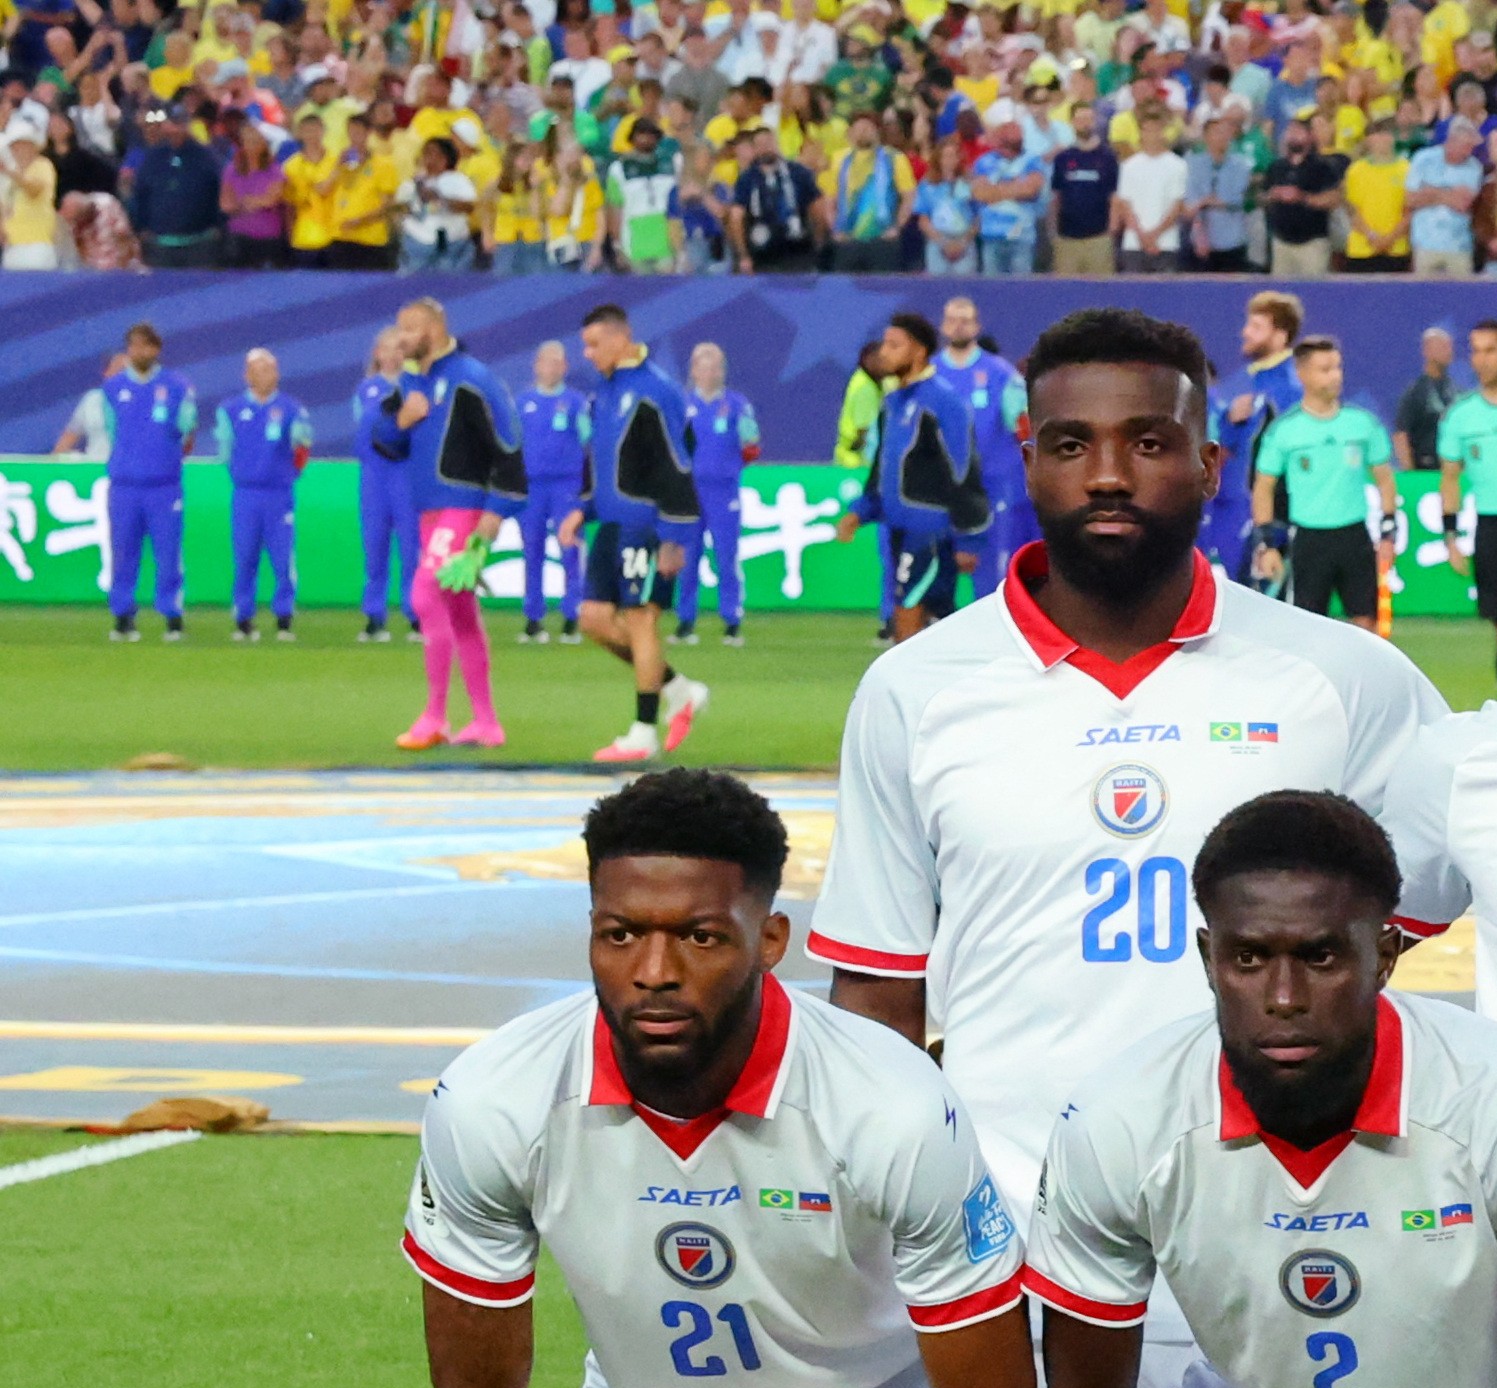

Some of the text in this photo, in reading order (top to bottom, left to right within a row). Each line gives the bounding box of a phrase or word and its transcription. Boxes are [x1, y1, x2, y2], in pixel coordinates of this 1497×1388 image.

[1076, 725, 1181, 746] SAETA
[1082, 856, 1187, 963] 20
[637, 1185, 741, 1207] SAETA
[1263, 1212, 1370, 1232] SAETA
[660, 1300, 762, 1377] 21
